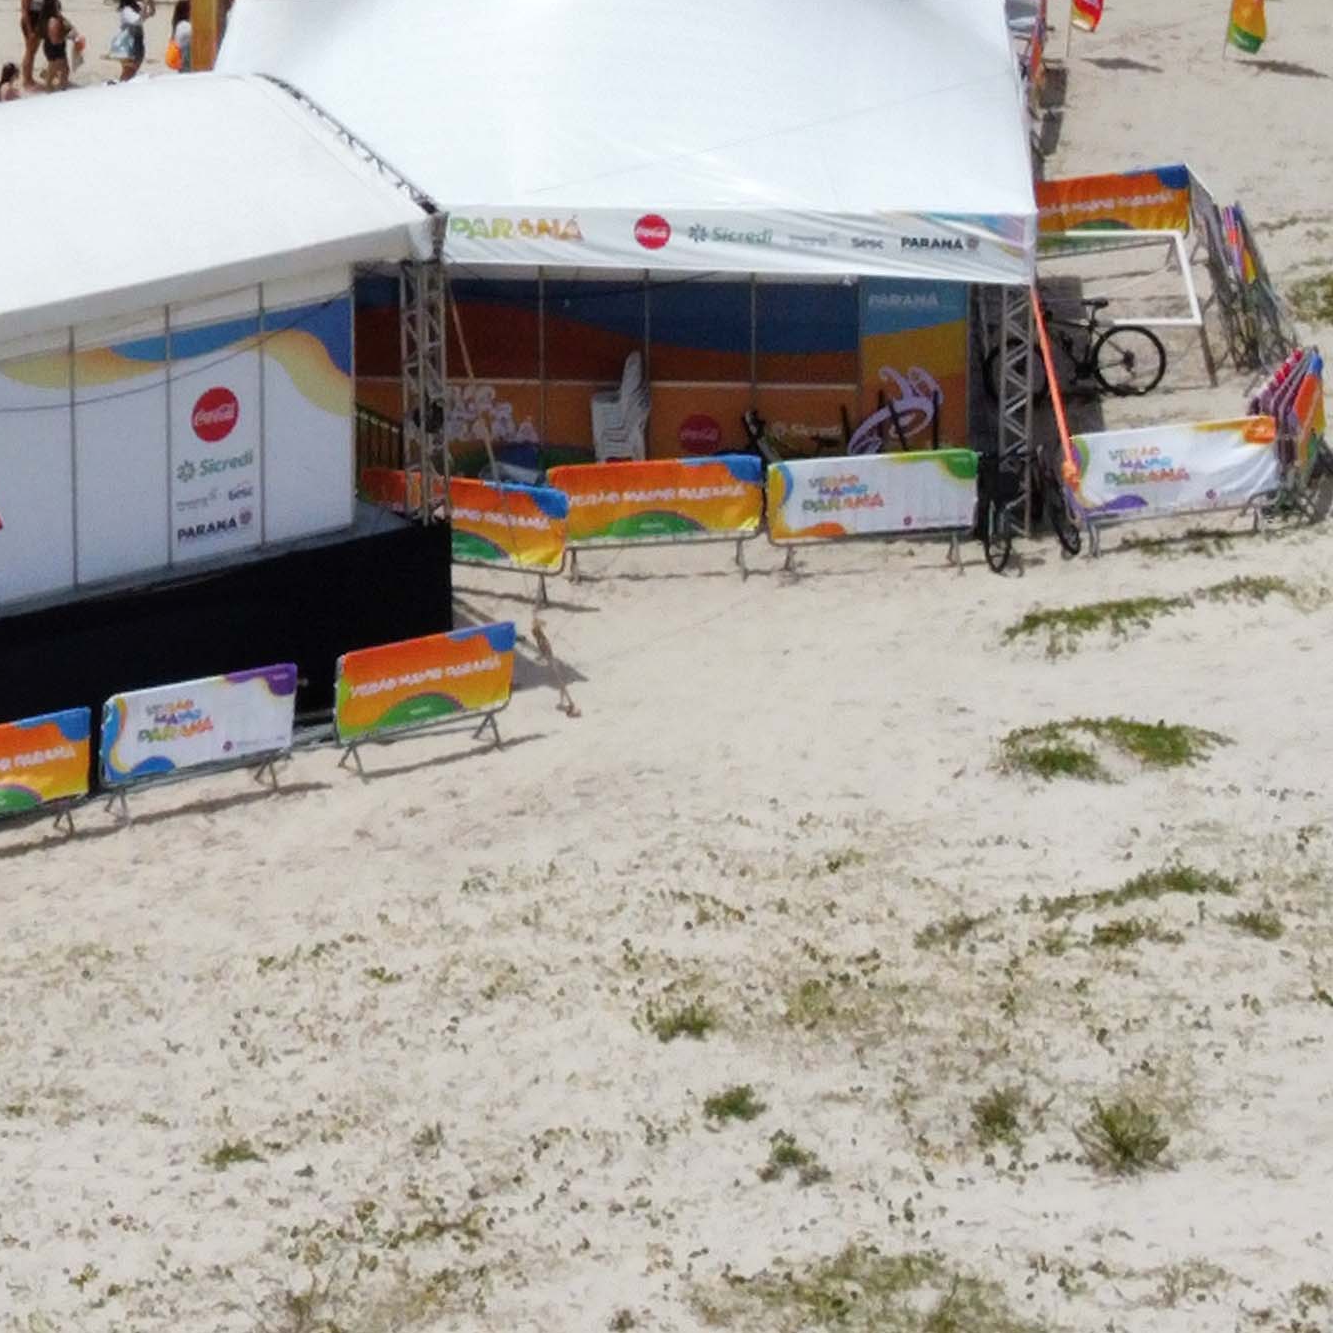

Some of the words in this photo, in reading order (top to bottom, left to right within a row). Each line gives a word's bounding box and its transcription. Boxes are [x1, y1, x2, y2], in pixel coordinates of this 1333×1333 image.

[449, 213, 585, 242] PARANÁ
[711, 226, 774, 244] Sicredi
[200, 449, 254, 477] Sicredi
